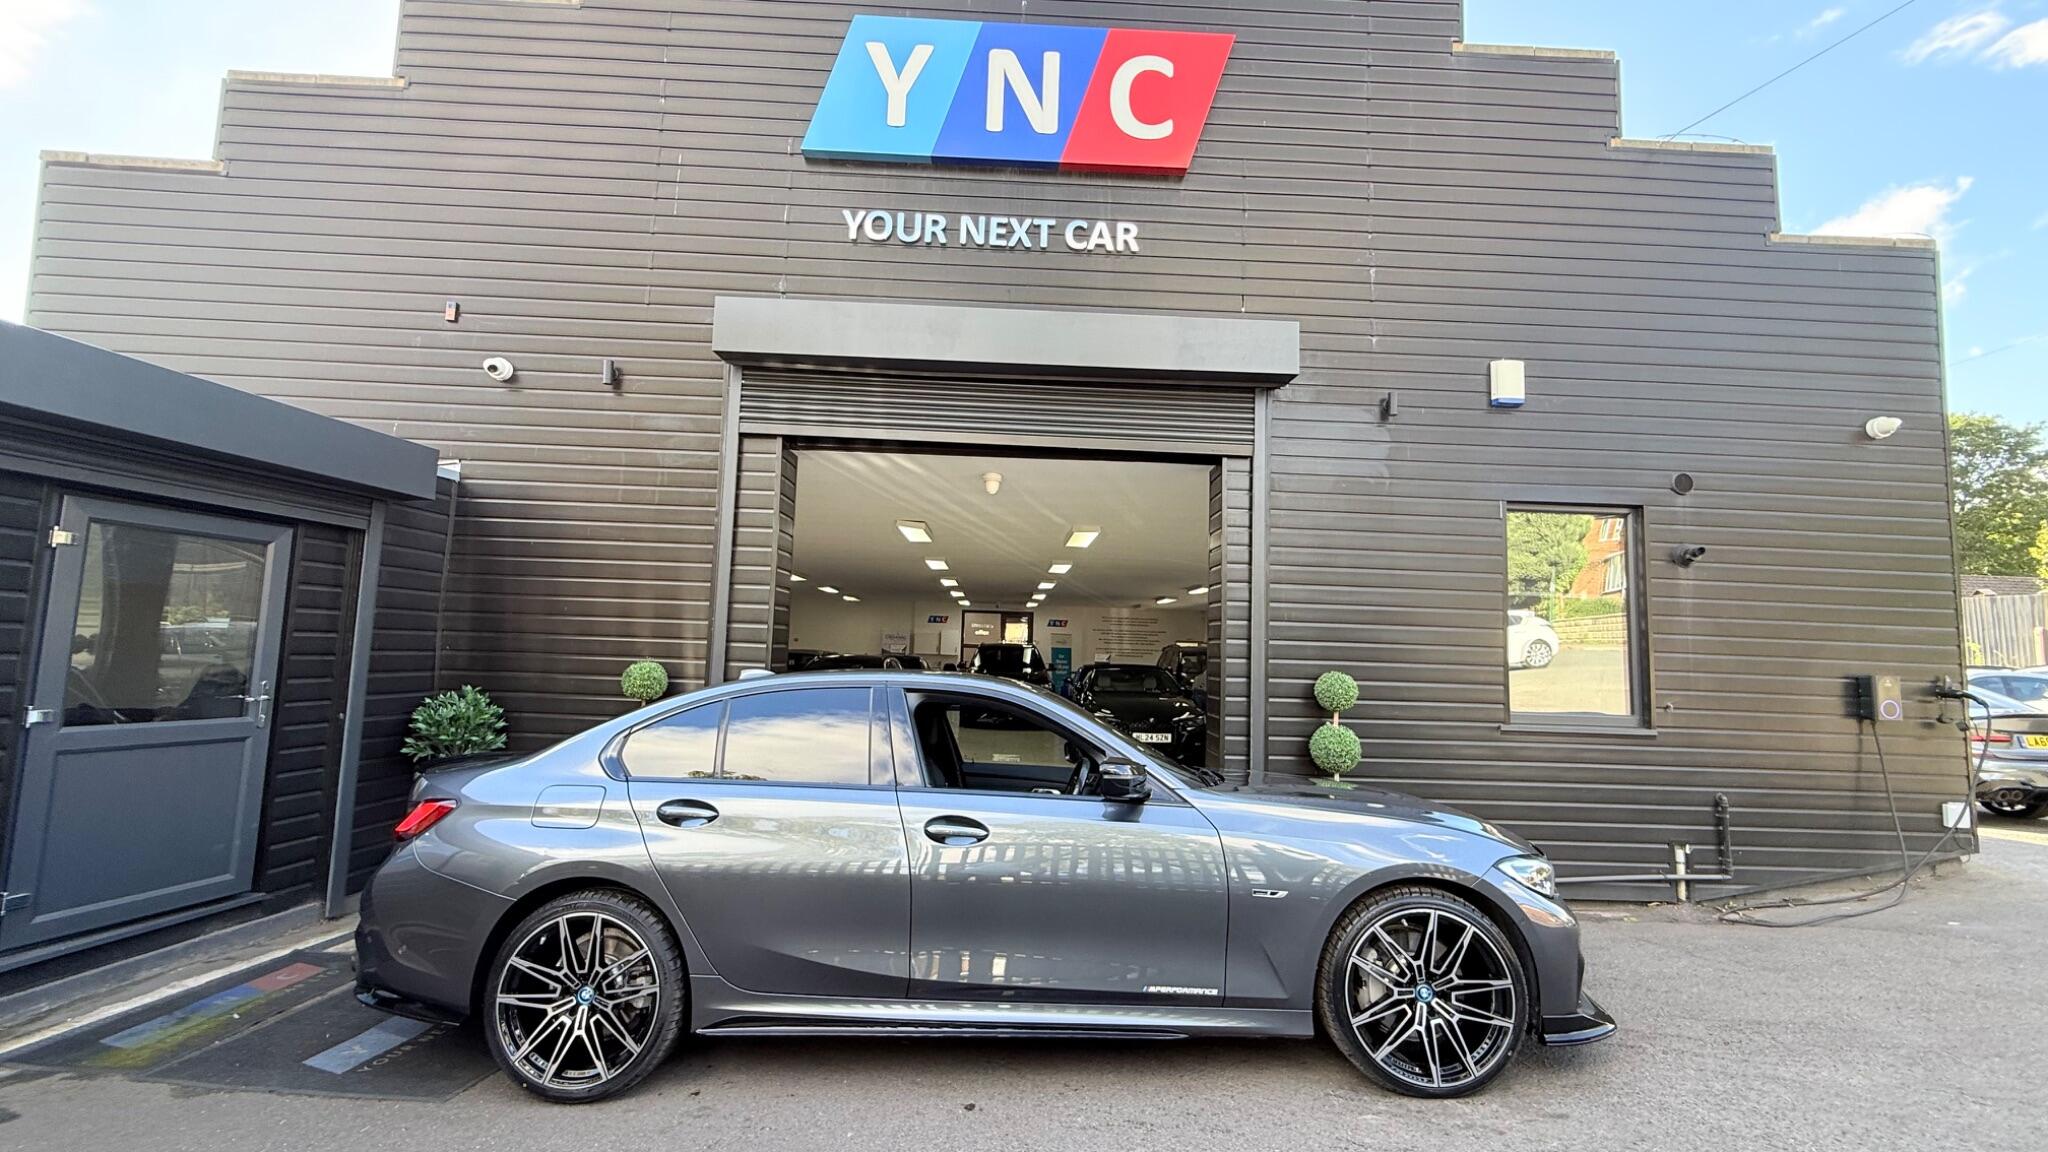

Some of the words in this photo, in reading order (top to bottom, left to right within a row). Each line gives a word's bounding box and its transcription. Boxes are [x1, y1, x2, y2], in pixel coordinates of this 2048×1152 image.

[864, 41, 1175, 140] YNC
[841, 208, 947, 245] YOUR
[959, 213, 1056, 249] NEXT
[1064, 218, 1140, 253] CAR
